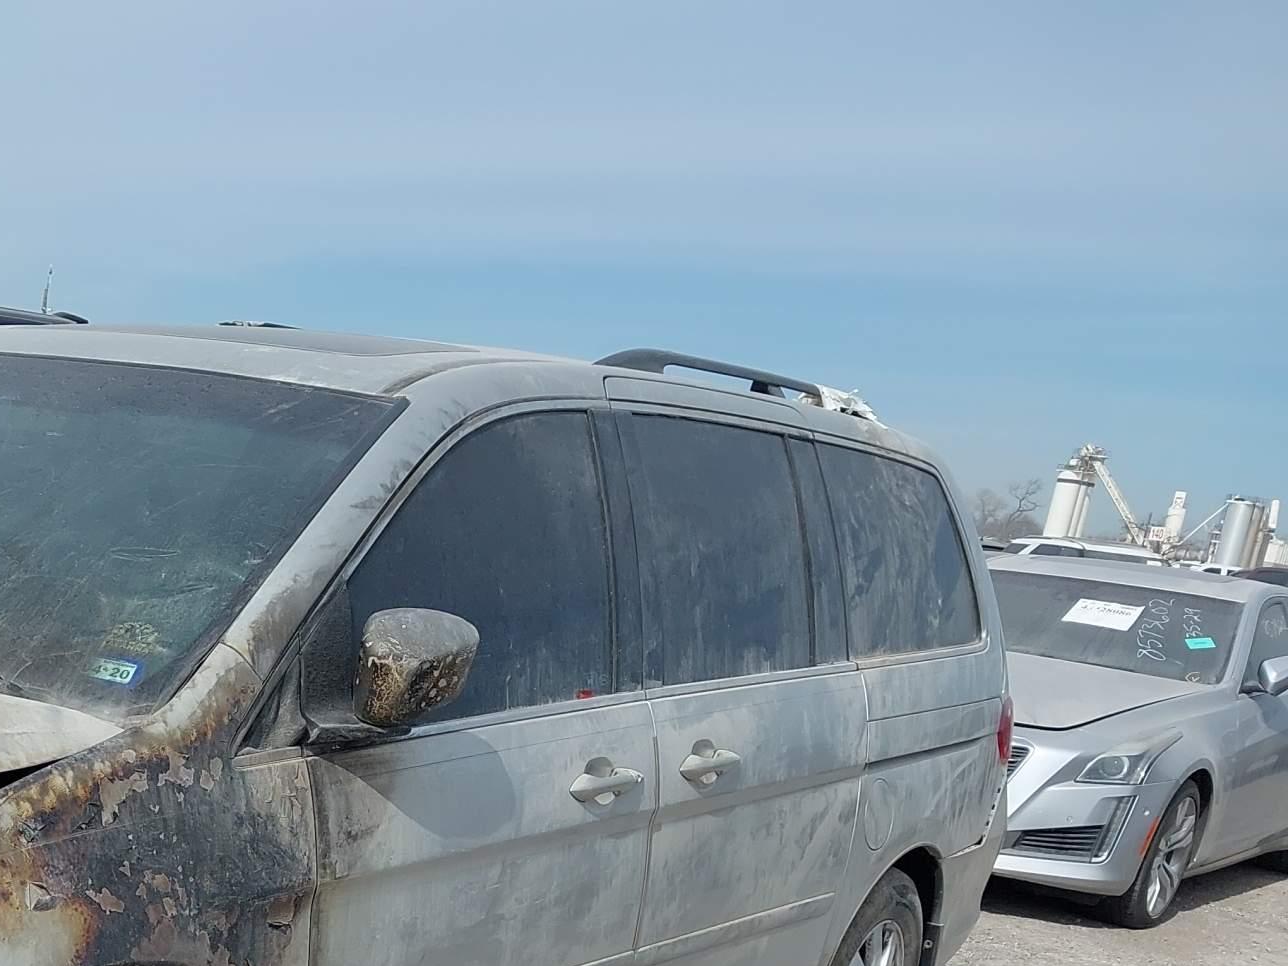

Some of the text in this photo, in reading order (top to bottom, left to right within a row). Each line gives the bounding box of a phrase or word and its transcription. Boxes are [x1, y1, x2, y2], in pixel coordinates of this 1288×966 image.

[1152, 528, 1164, 539] 140
[1136, 598, 1176, 661] 8573602
[109, 667, 130, 680] 20
